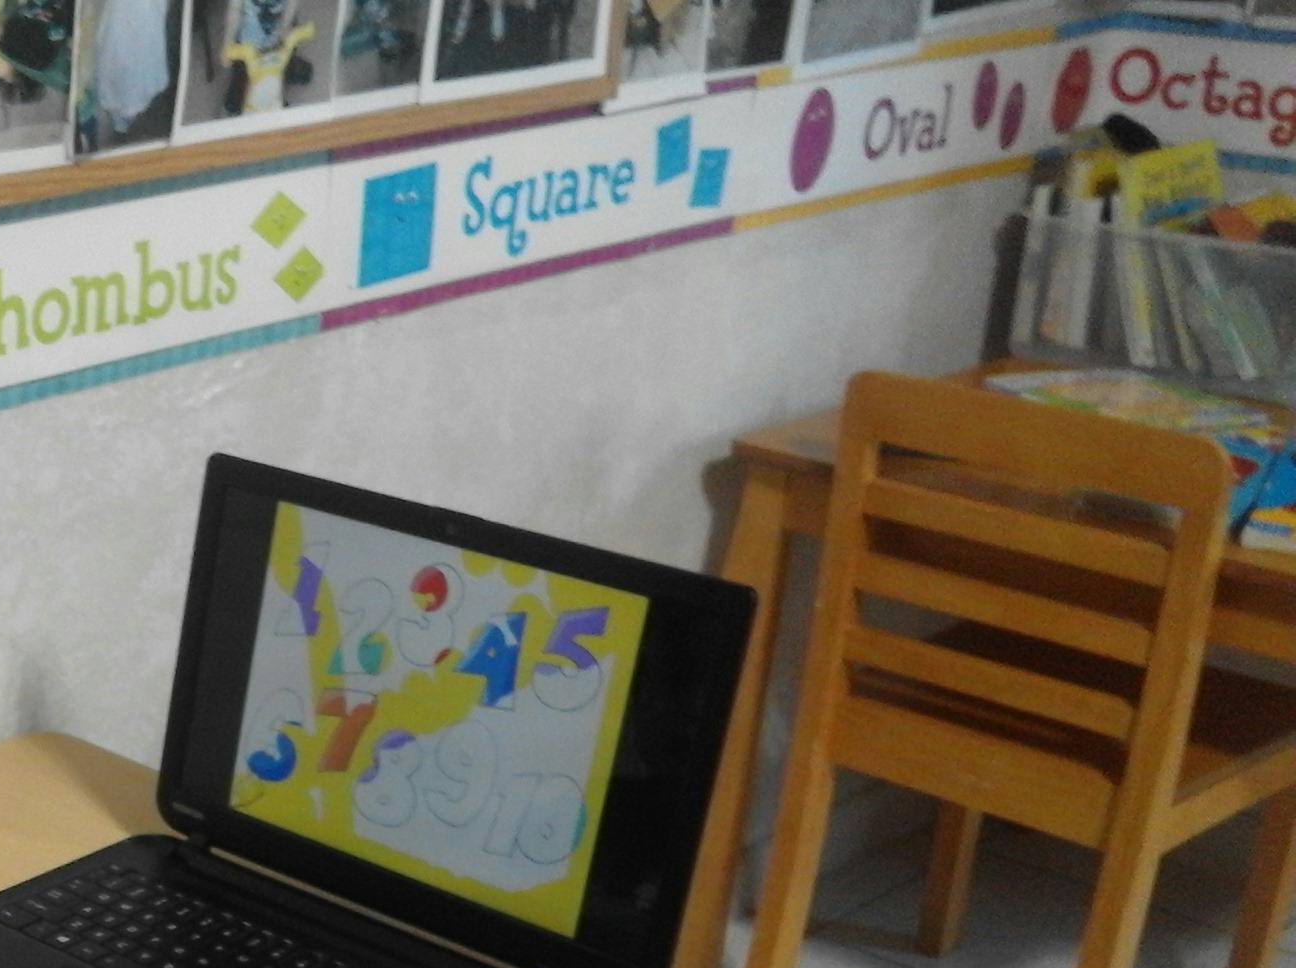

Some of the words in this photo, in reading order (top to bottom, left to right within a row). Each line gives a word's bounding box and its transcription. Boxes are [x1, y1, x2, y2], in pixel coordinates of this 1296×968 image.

[864, 83, 953, 160] Oval
[463, 156, 635, 256] Square
[453, 611, 527, 711] 4
[532, 606, 610, 712] 5
[315, 687, 378, 773] 7
